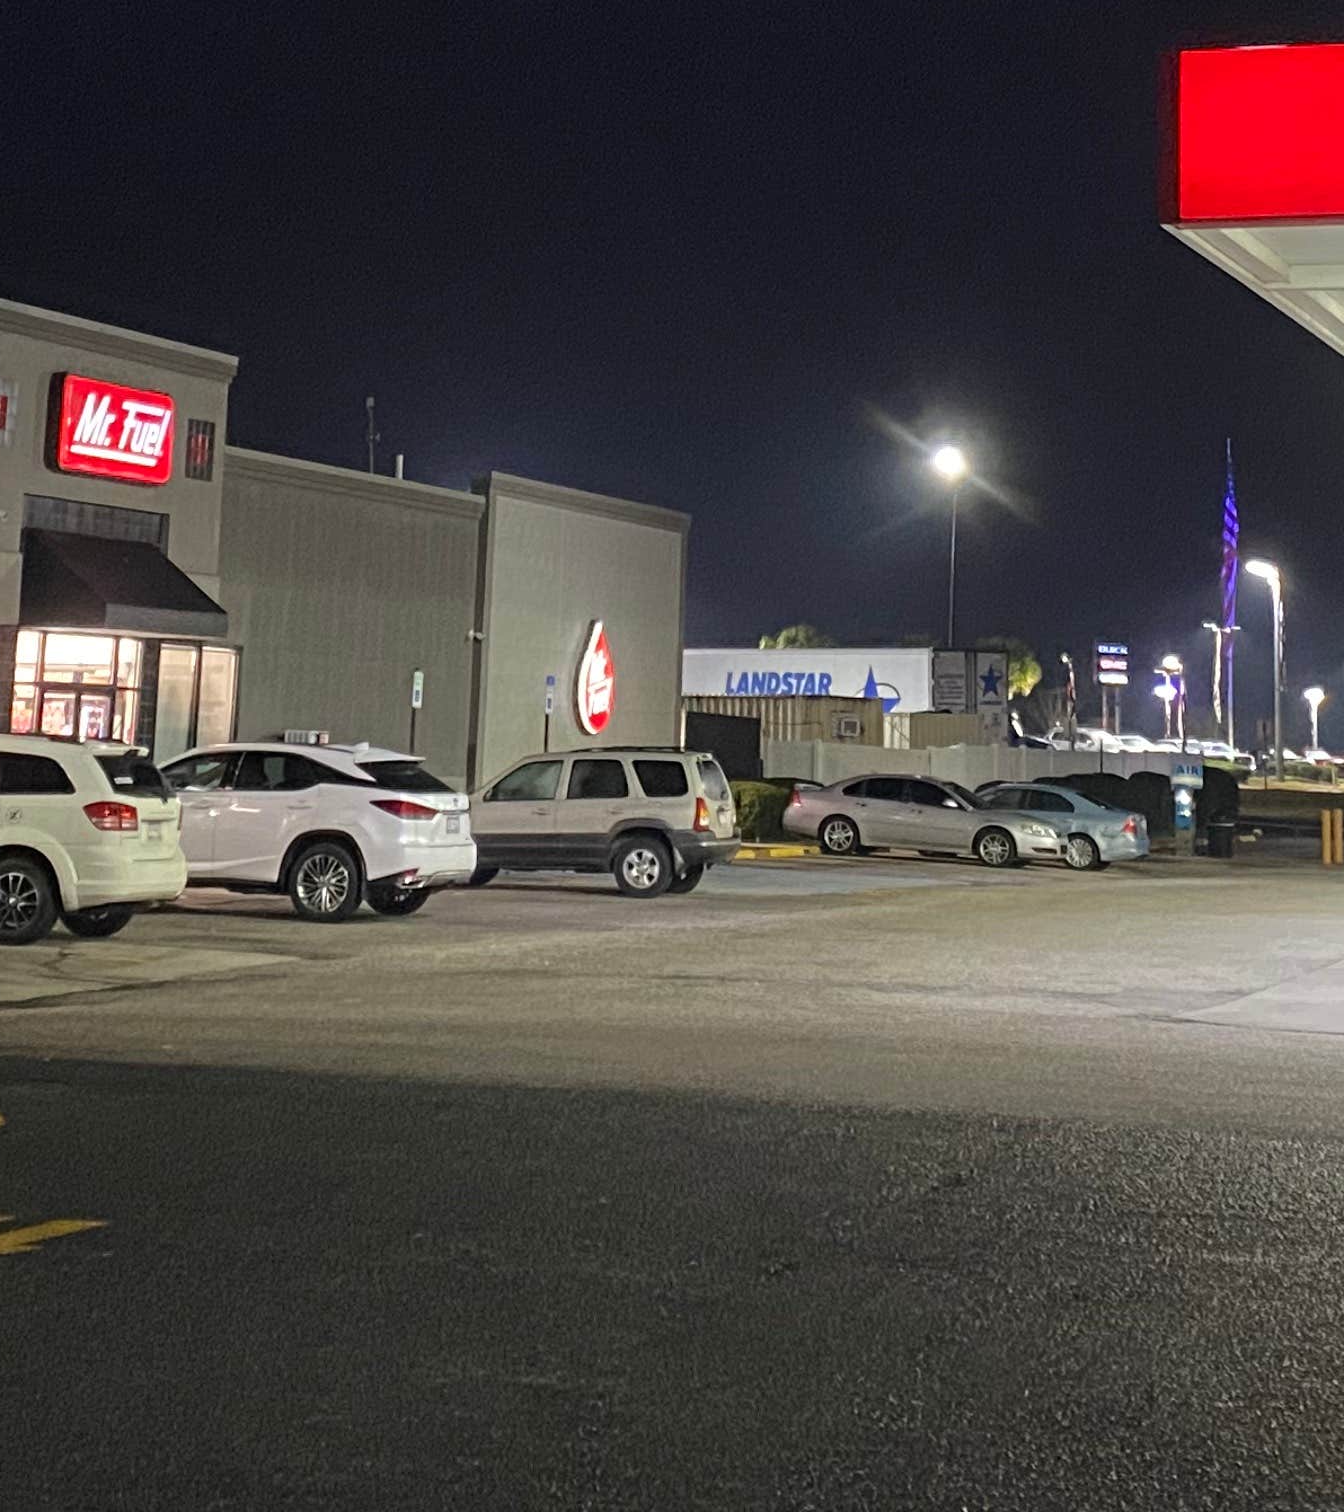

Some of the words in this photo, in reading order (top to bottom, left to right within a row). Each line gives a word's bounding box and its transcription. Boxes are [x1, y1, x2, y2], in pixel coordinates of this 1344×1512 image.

[73, 392, 117, 446] Mr.
[117, 400, 172, 457] Fuel
[725, 671, 833, 696] LANDSTAR
[1176, 765, 1200, 776] AIR
